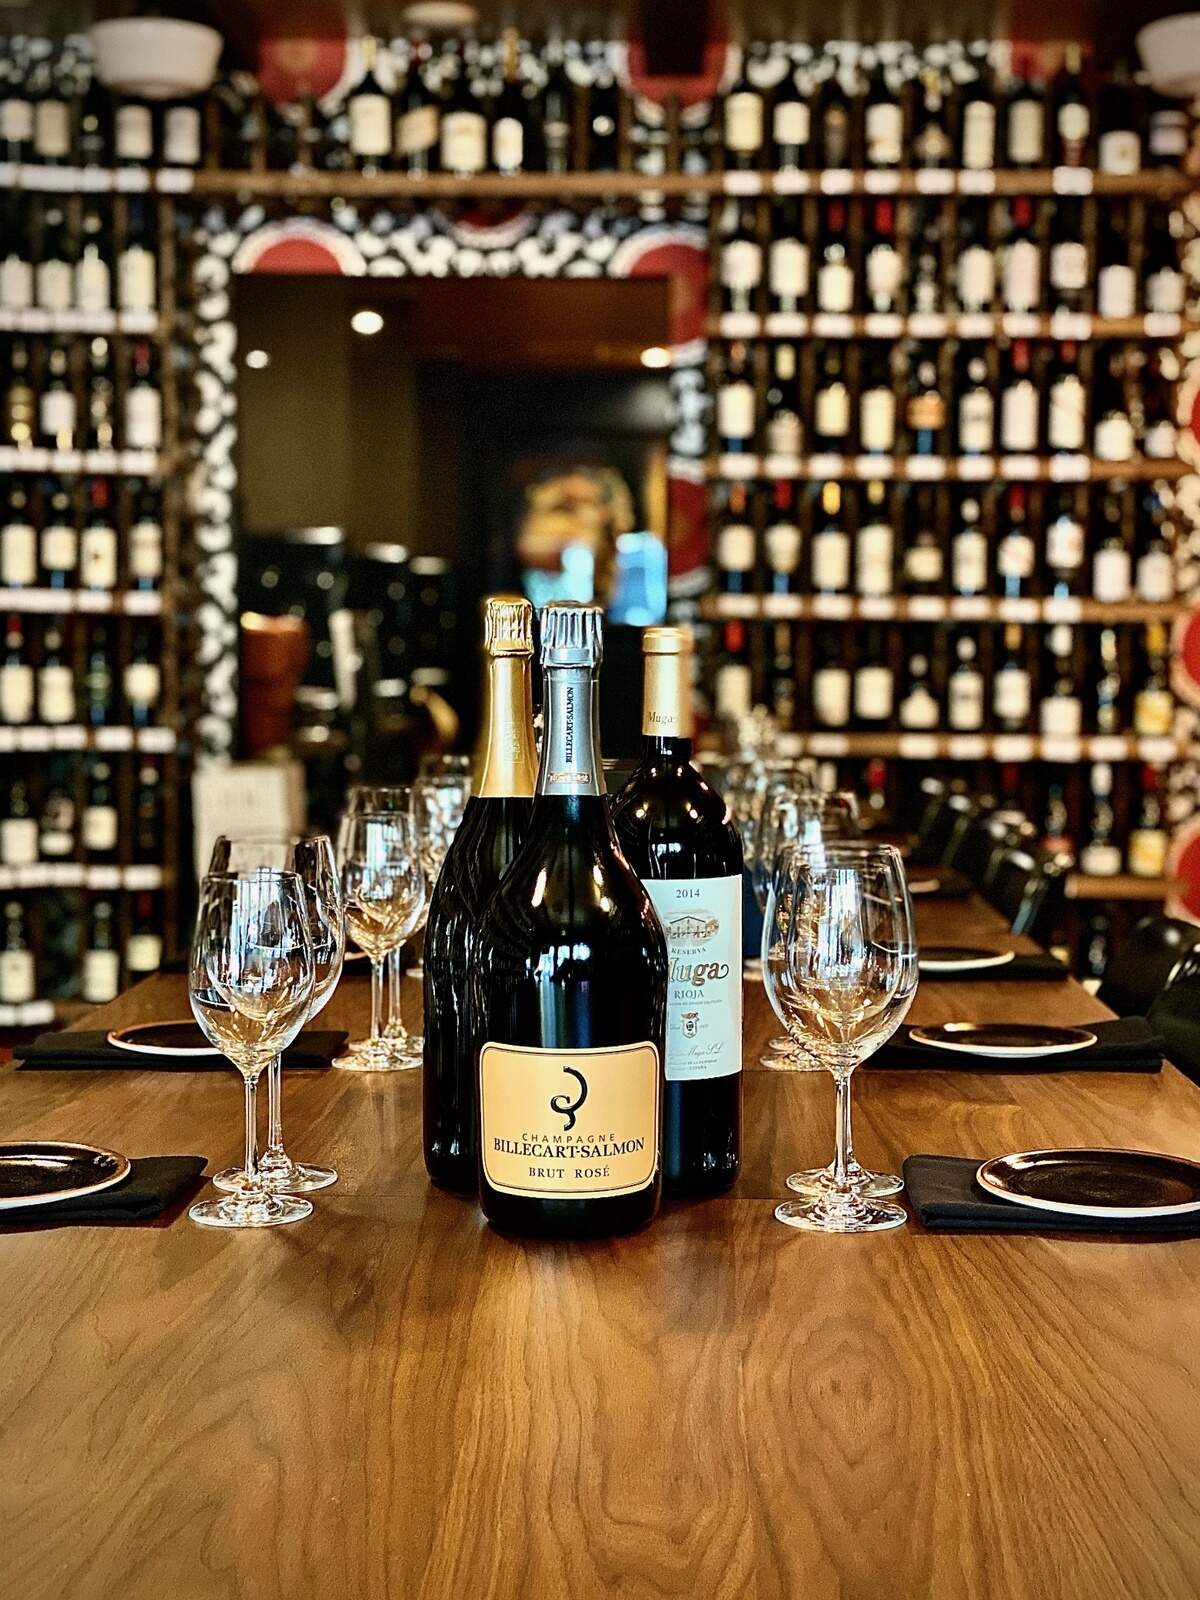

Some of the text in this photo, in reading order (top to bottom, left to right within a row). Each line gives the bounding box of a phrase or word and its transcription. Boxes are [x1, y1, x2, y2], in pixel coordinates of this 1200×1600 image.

[676, 888, 700, 899] 2014
[671, 946, 707, 955] RESERVA
[673, 989, 705, 1000] RIOJA
[521, 1132, 616, 1144] CHAMPAGNE
[493, 1136, 645, 1159] BILLECART-SALMON
[528, 1164, 610, 1179] BRUT ROSÉ
